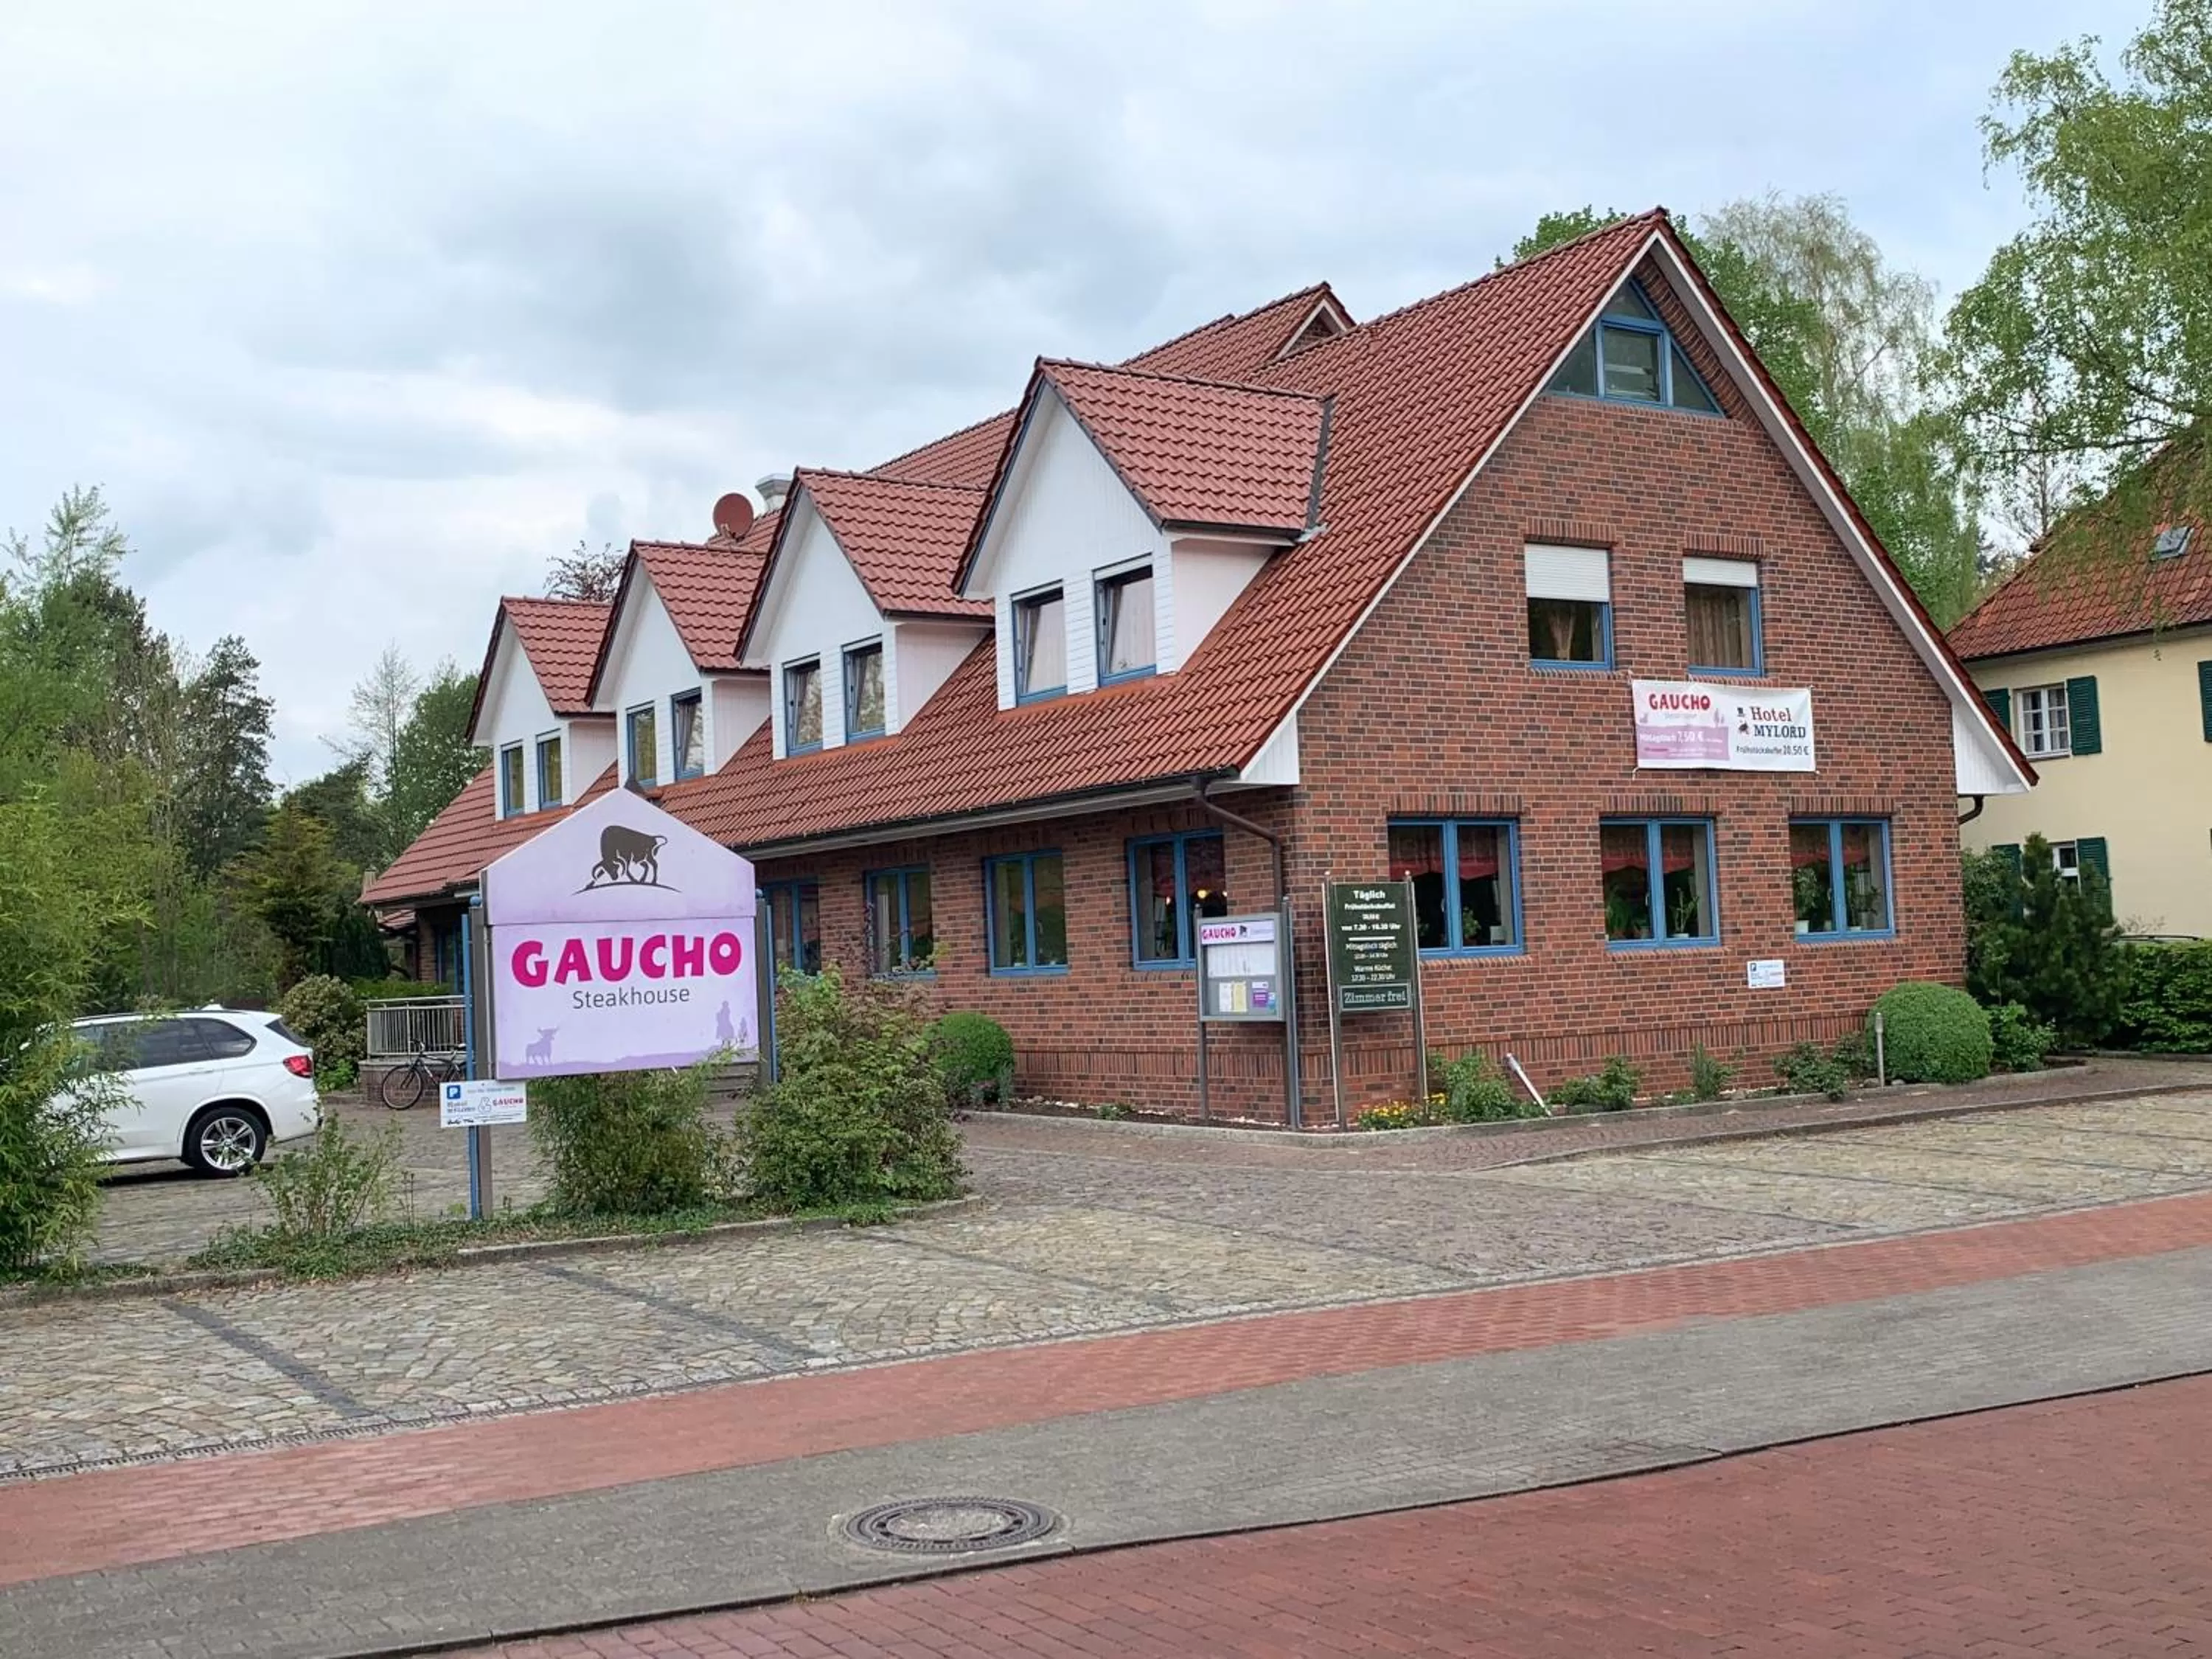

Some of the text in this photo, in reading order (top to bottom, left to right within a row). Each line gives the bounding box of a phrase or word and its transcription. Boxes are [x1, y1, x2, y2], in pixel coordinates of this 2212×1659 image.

[1649, 693, 1711, 710] GAUCHO
[1750, 706, 1792, 722] Hotel
[1753, 725, 1806, 738] MYLORD
[1353, 889, 1385, 902] Täglich
[1203, 927, 1236, 940] GAUCHO
[512, 932, 742, 988] GAUCHO
[572, 986, 690, 1010] Steakhouse
[1344, 992, 1385, 1004] Zimmer
[449, 1088, 459, 1098] P
[492, 1097, 524, 1106] GAUCHO
